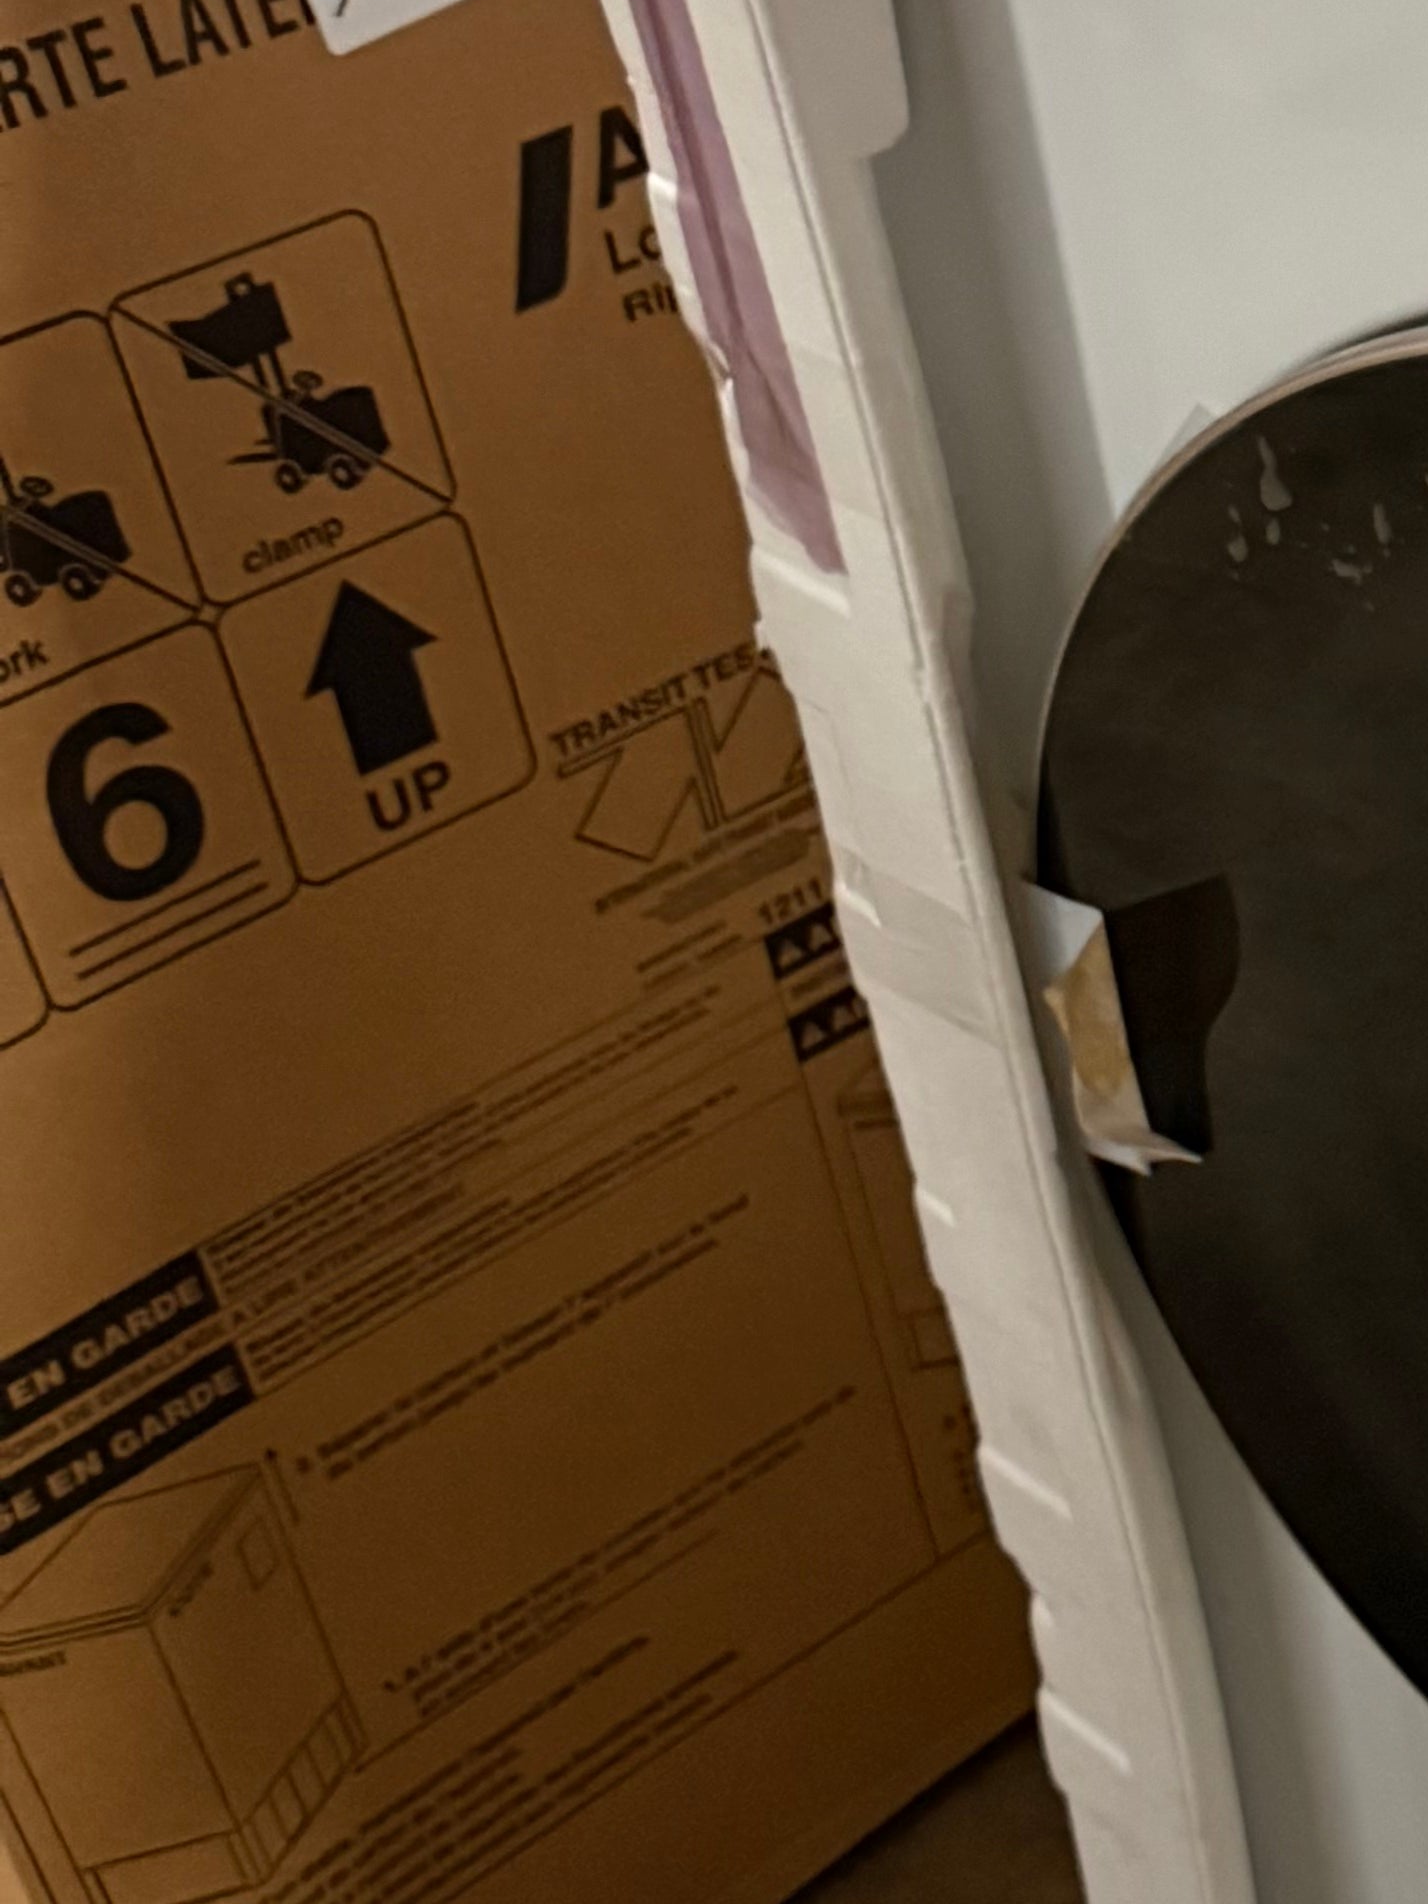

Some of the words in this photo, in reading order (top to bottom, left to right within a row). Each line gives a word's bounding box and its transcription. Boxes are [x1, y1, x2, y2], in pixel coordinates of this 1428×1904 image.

[0, 15, 128, 132] RTE
[241, 516, 345, 574] clamp
[549, 675, 691, 757] TRANSIT
[692, 643, 771, 694] TES
[46, 701, 206, 902] 6
[365, 758, 451, 832] UP
[7, 1359, 66, 1411] EN
[70, 1275, 204, 1370] GARDE
[46, 1449, 104, 1499] EN
[108, 1364, 243, 1459] GARDE
